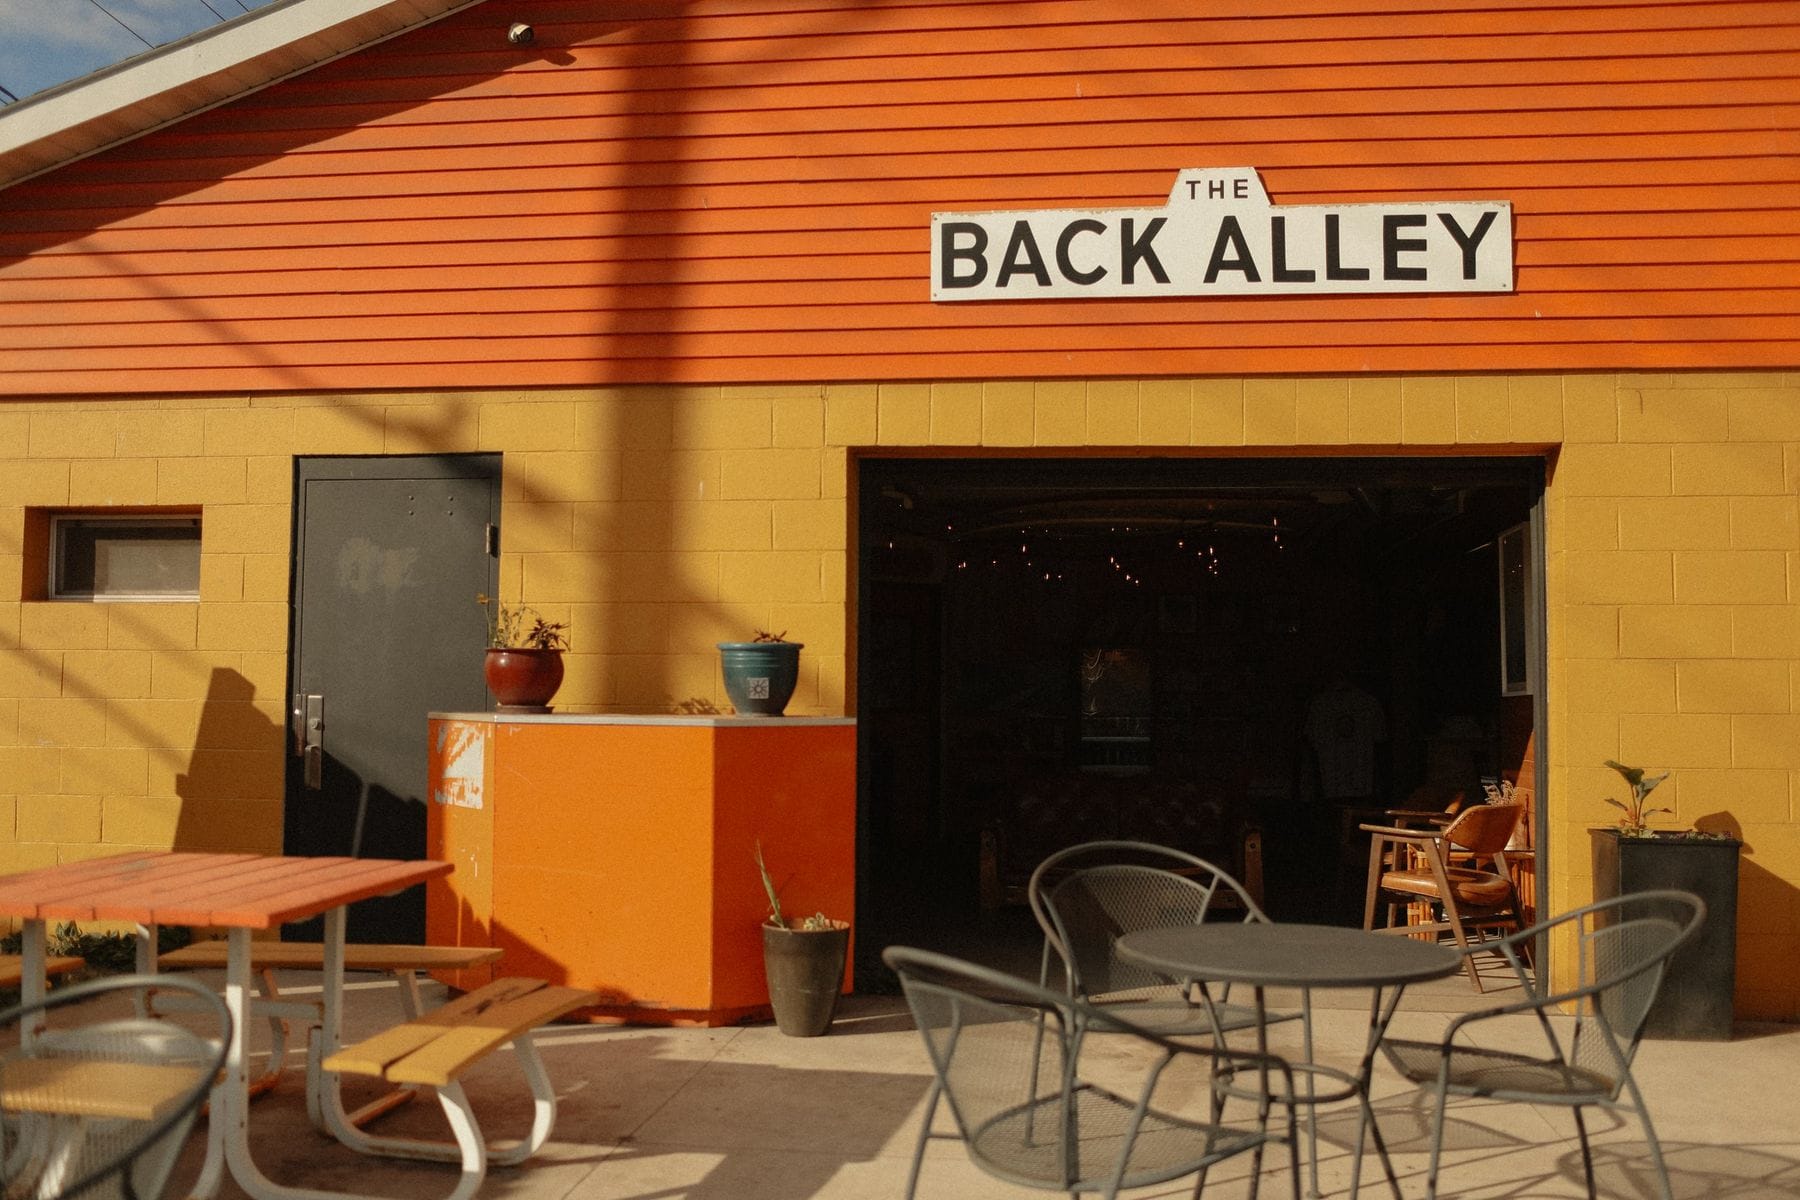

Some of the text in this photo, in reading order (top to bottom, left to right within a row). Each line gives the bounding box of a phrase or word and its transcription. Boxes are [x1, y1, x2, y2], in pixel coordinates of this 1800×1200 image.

[1186, 179, 1249, 200] THE
[941, 211, 1498, 289] BACK ALLEY
